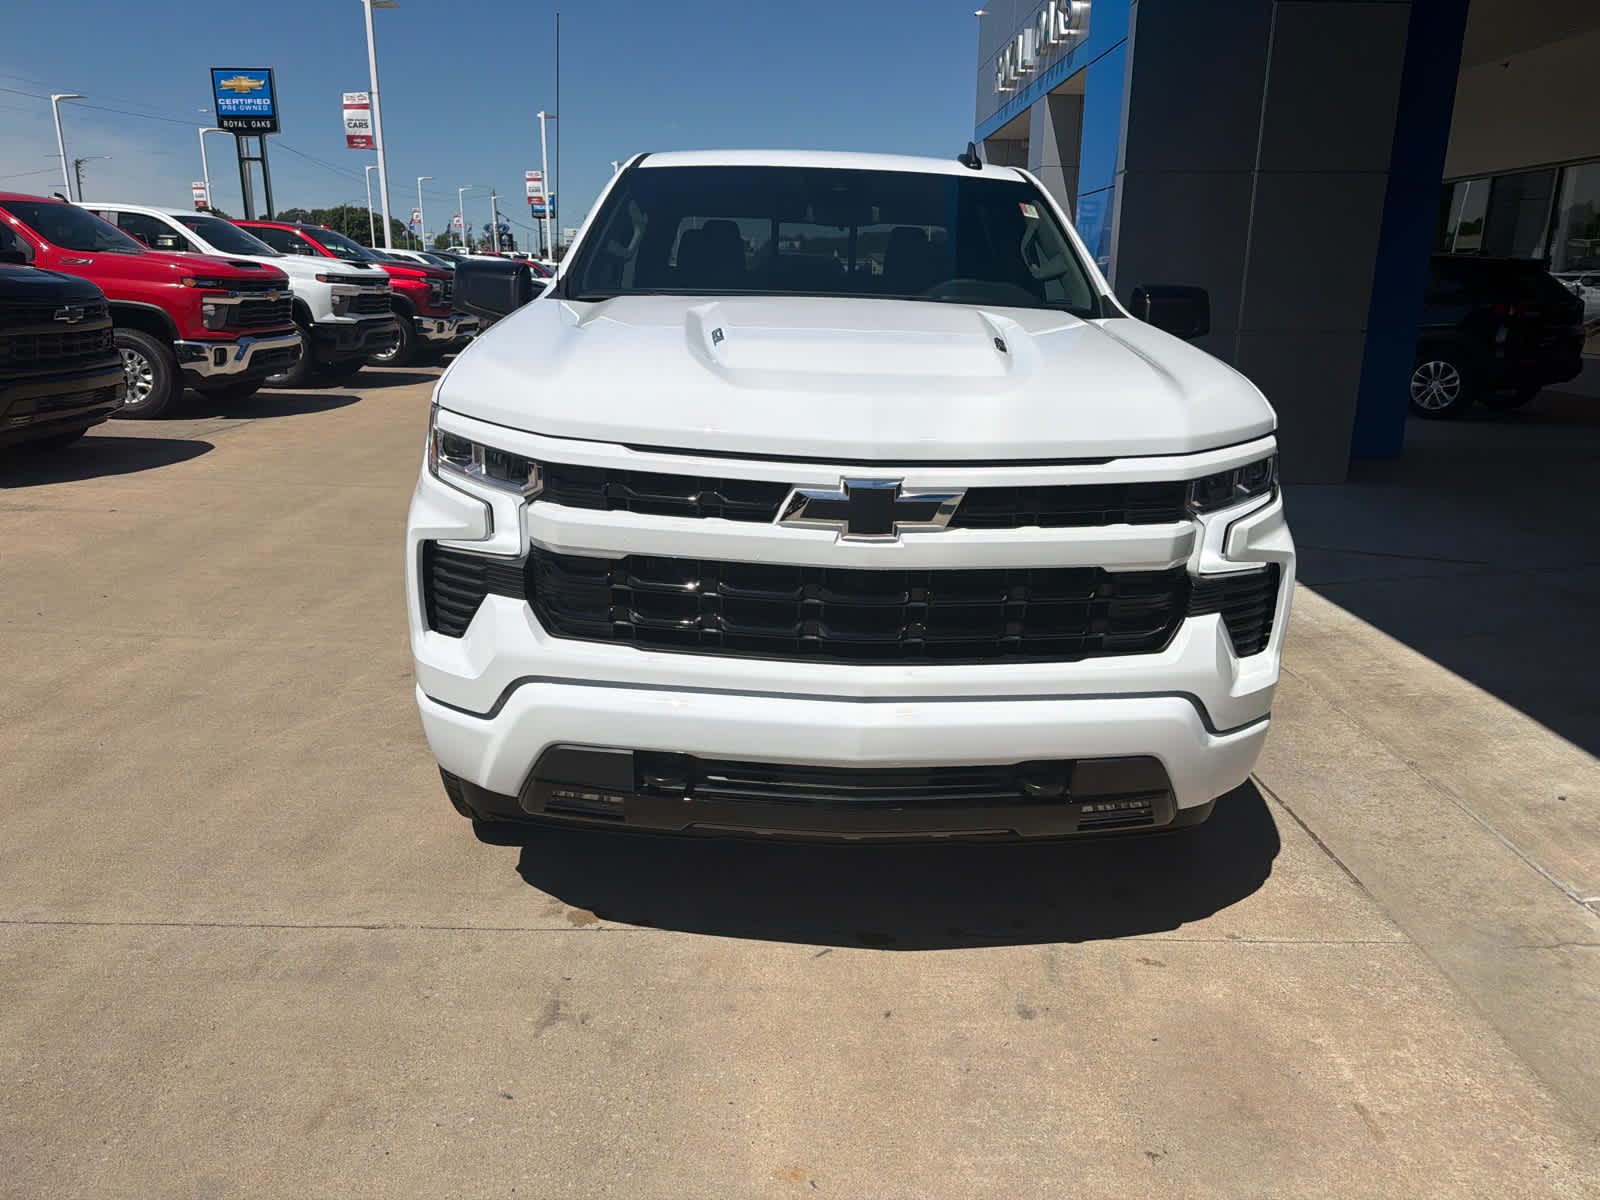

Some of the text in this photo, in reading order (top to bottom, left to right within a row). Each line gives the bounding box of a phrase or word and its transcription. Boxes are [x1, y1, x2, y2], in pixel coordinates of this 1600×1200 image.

[223, 120, 271, 128] ROYAL OAKS
[347, 121, 369, 129] CARS
